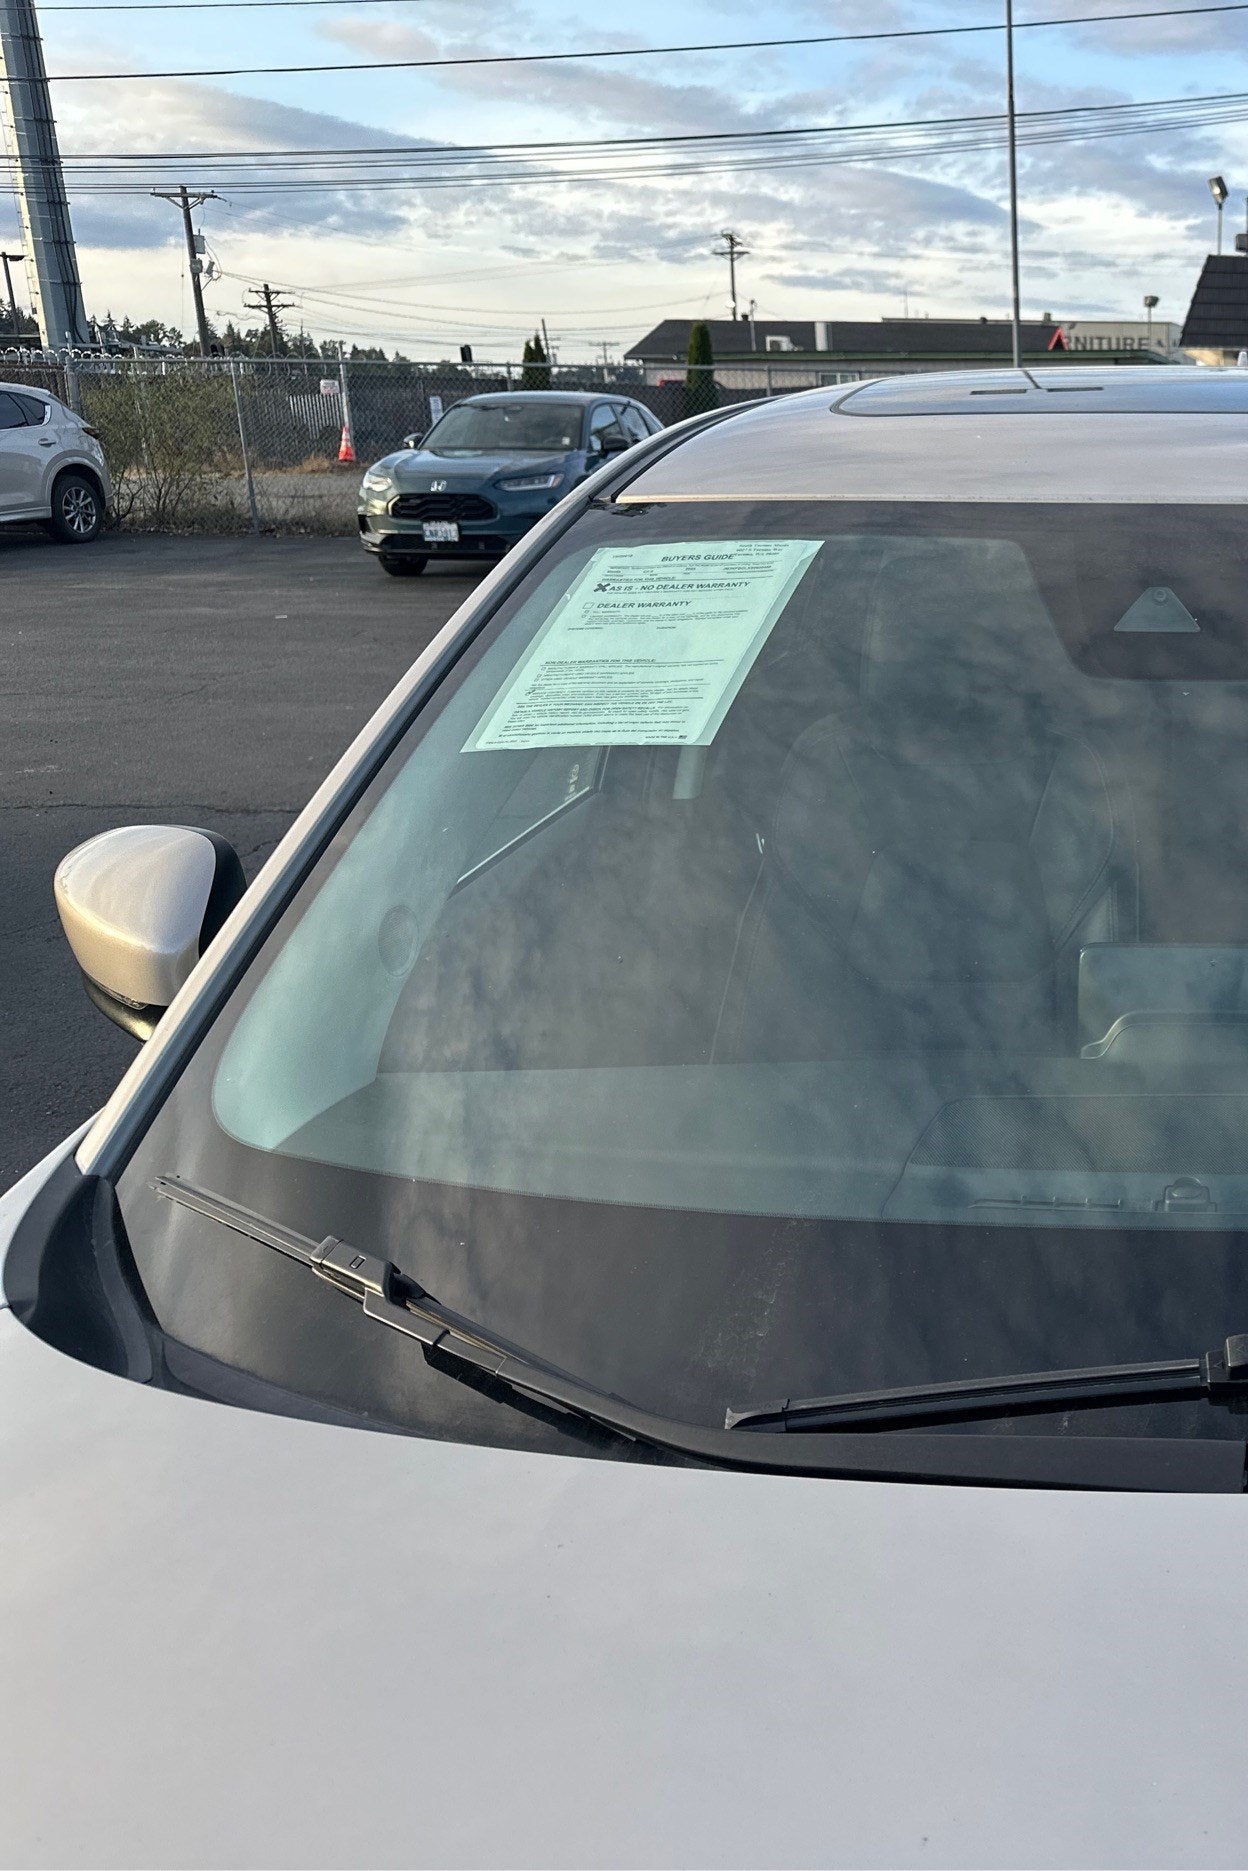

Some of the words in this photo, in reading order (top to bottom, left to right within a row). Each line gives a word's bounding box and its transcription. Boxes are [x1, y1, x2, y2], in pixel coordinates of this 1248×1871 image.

[661, 554, 702, 563] BUYERS
[703, 553, 735, 561] GUIDE
[608, 584, 623, 592] AS
[624, 584, 633, 592] IS
[640, 583, 655, 591] NO
[656, 582, 697, 591] DEALER
[698, 581, 751, 590] WARRANTY
[638, 600, 692, 608] WARRANTY
